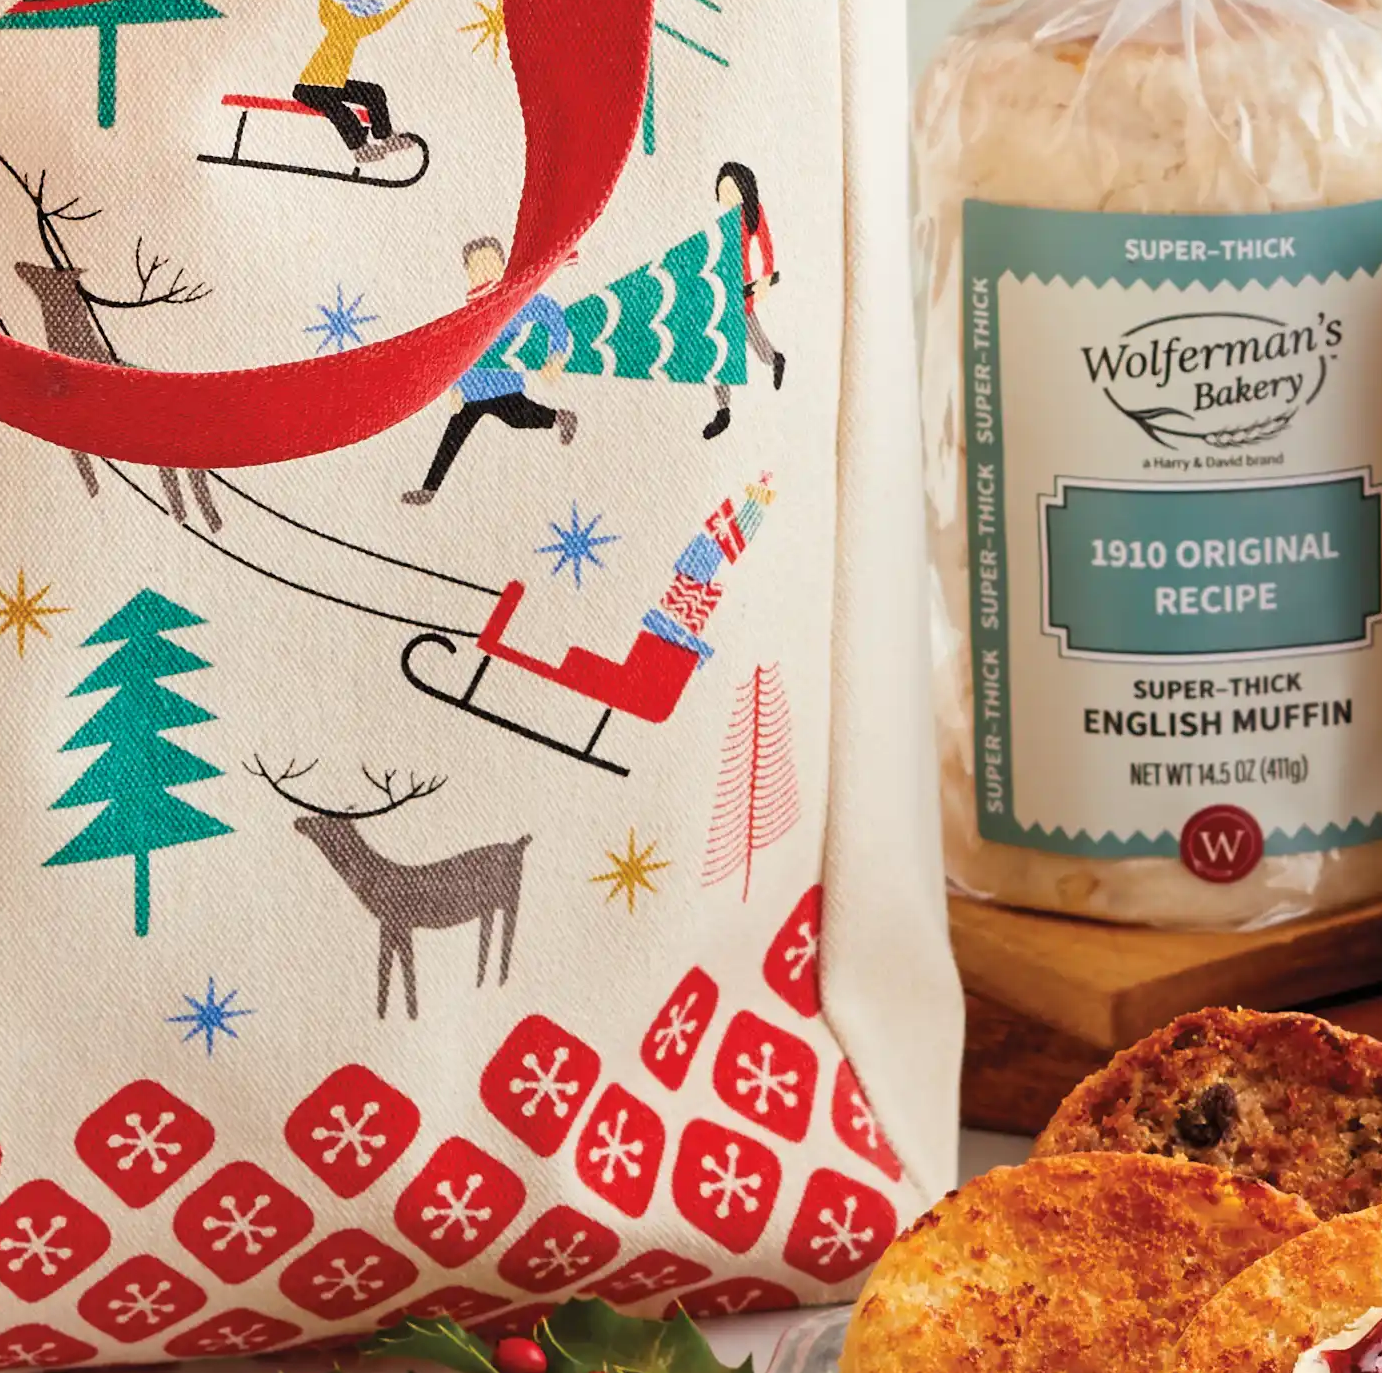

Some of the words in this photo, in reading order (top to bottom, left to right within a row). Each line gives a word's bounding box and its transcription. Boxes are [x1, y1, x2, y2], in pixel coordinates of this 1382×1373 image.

[1123, 237, 1296, 262] SUPER-THICK
[972, 276, 994, 444] SUPER-THICK
[1081, 312, 1342, 388] Wolferman's
[1194, 373, 1304, 411] Bakery
[1142, 459, 1151, 469] a
[1154, 456, 1189, 471] Harry
[1193, 456, 1203, 469] &
[1206, 455, 1242, 468] David
[1246, 452, 1284, 467] brand
[974, 462, 998, 630] SUPER-THICK
[1090, 539, 1167, 569] 1910
[1175, 532, 1340, 569] ORIGINAL
[1155, 582, 1278, 615] RECIPE
[1133, 672, 1303, 700] SUPER-THICK
[981, 649, 1004, 814] SUPER-THICK
[1084, 708, 1222, 737] ENGLISH
[1232, 698, 1353, 734] MUFFIN
[1130, 762, 1162, 786] NET
[1166, 763, 1194, 786] WT
[1198, 763, 1230, 786] 14.5
[1235, 759, 1256, 784] OZ
[1260, 754, 1309, 785] (411g)
[1199, 829, 1246, 864] W
